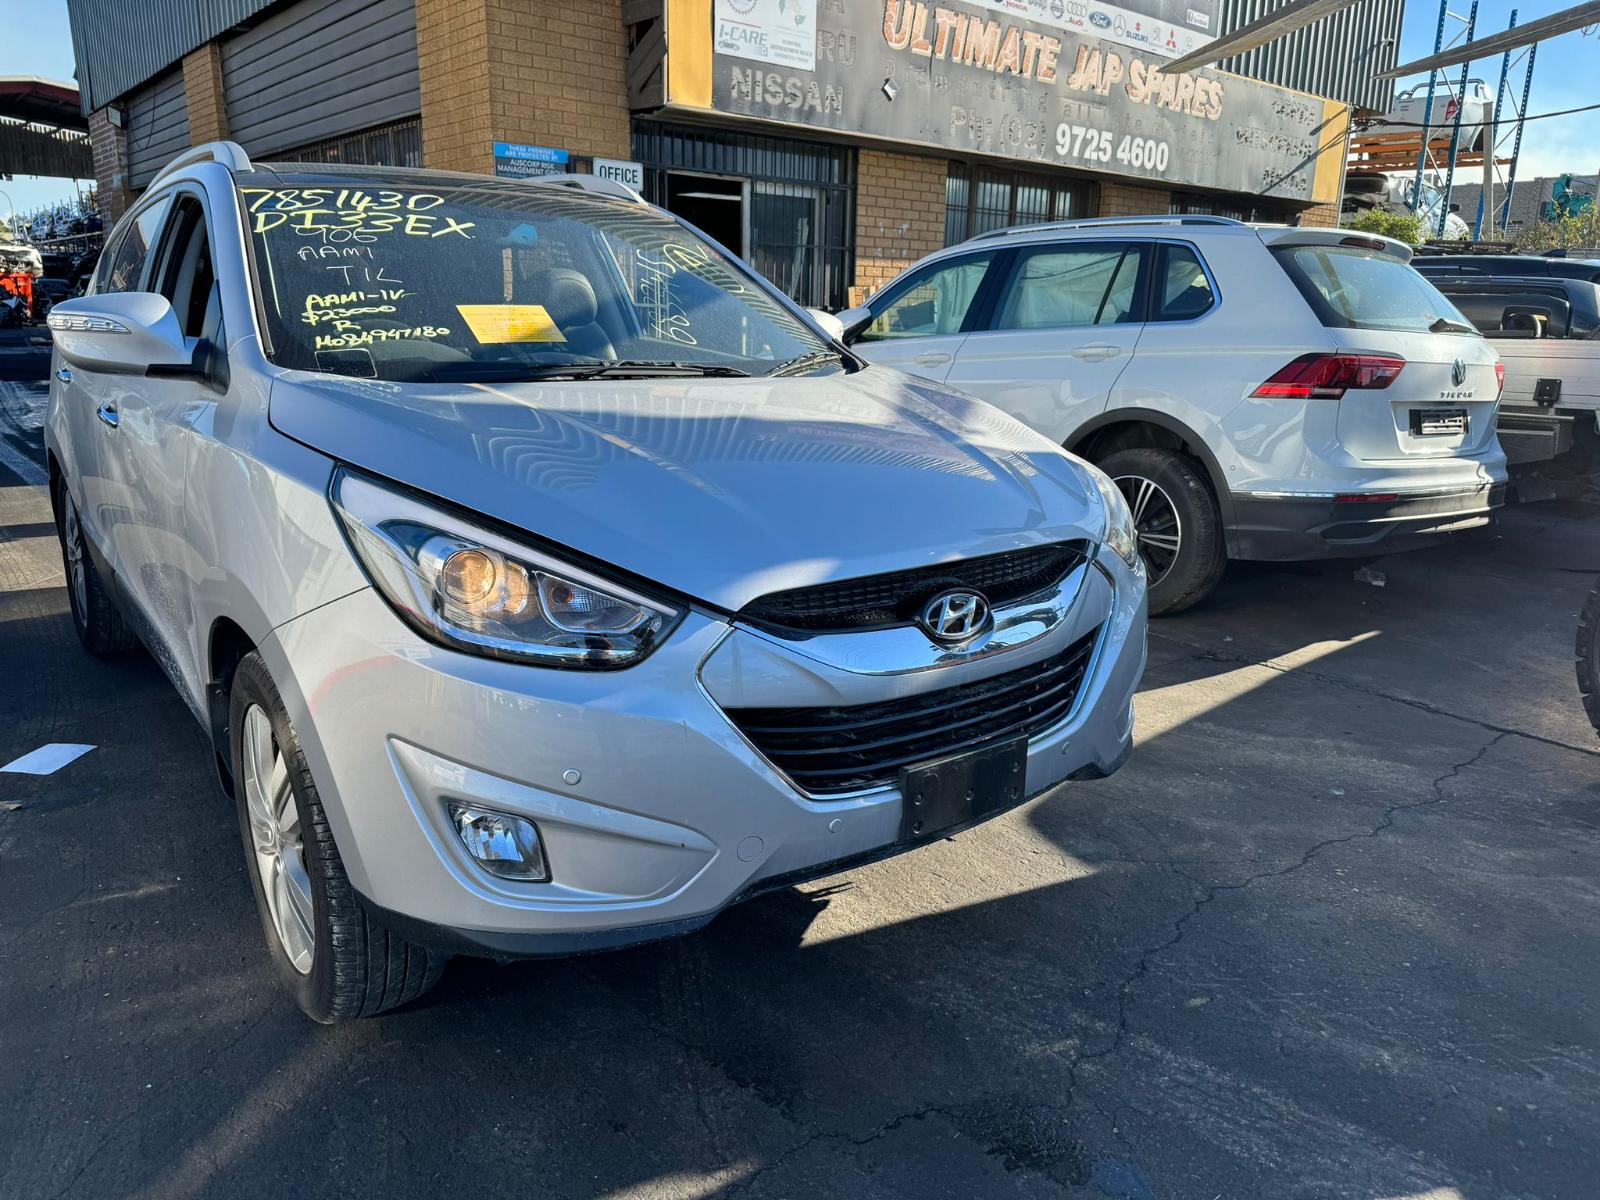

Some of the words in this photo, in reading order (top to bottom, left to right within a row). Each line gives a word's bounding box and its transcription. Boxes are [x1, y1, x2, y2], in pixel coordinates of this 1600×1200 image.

[719, 24, 768, 47] I-CARE
[1125, 31, 1148, 43] SUZUKI
[882, 0, 1062, 85] ULTIMATE
[1067, 44, 1123, 96] JAP
[1125, 59, 1224, 121] SPARES
[731, 65, 843, 115] NISSAN
[1055, 122, 1113, 162] 9725
[1116, 135, 1169, 172] 4600
[497, 164, 544, 176] MANAGEMENT
[510, 159, 540, 168] AUSCORP
[541, 162, 555, 170] RISK
[599, 165, 638, 184] OFFICE
[241, 188, 445, 213] 7851430
